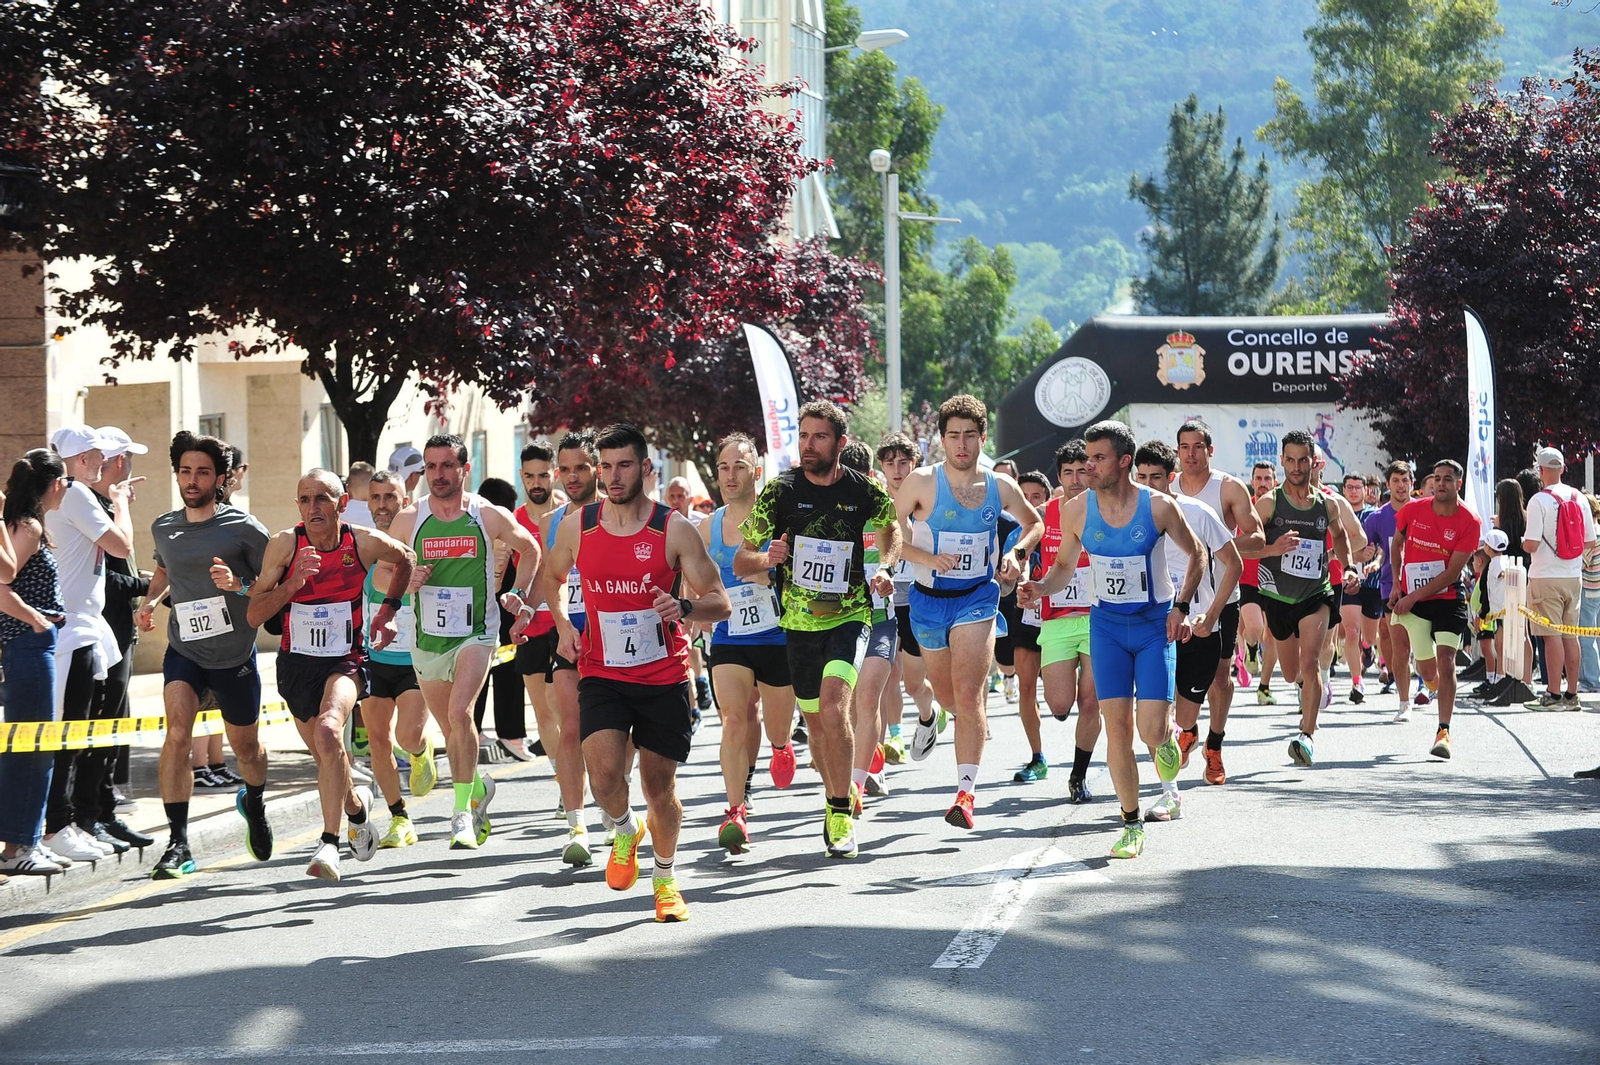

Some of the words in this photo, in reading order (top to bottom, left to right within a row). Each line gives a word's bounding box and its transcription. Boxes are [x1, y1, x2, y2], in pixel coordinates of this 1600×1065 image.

[1227, 328, 1317, 346] Concello
[1324, 327, 1349, 344] de
[1272, 382, 1328, 394] Deportes
[424, 538, 475, 549] mandarina
[424, 549, 449, 558] home
[1291, 554, 1311, 571] 134
[801, 560, 835, 584] 206
[588, 580, 603, 594] LA
[606, 580, 648, 594] GANGA
[1064, 585, 1078, 600] 21
[1105, 577, 1127, 596] 32
[189, 615, 213, 634] 912
[437, 609, 446, 628] 5
[739, 605, 761, 626] 28
[310, 627, 327, 648] 111
[624, 636, 637, 657] 4
